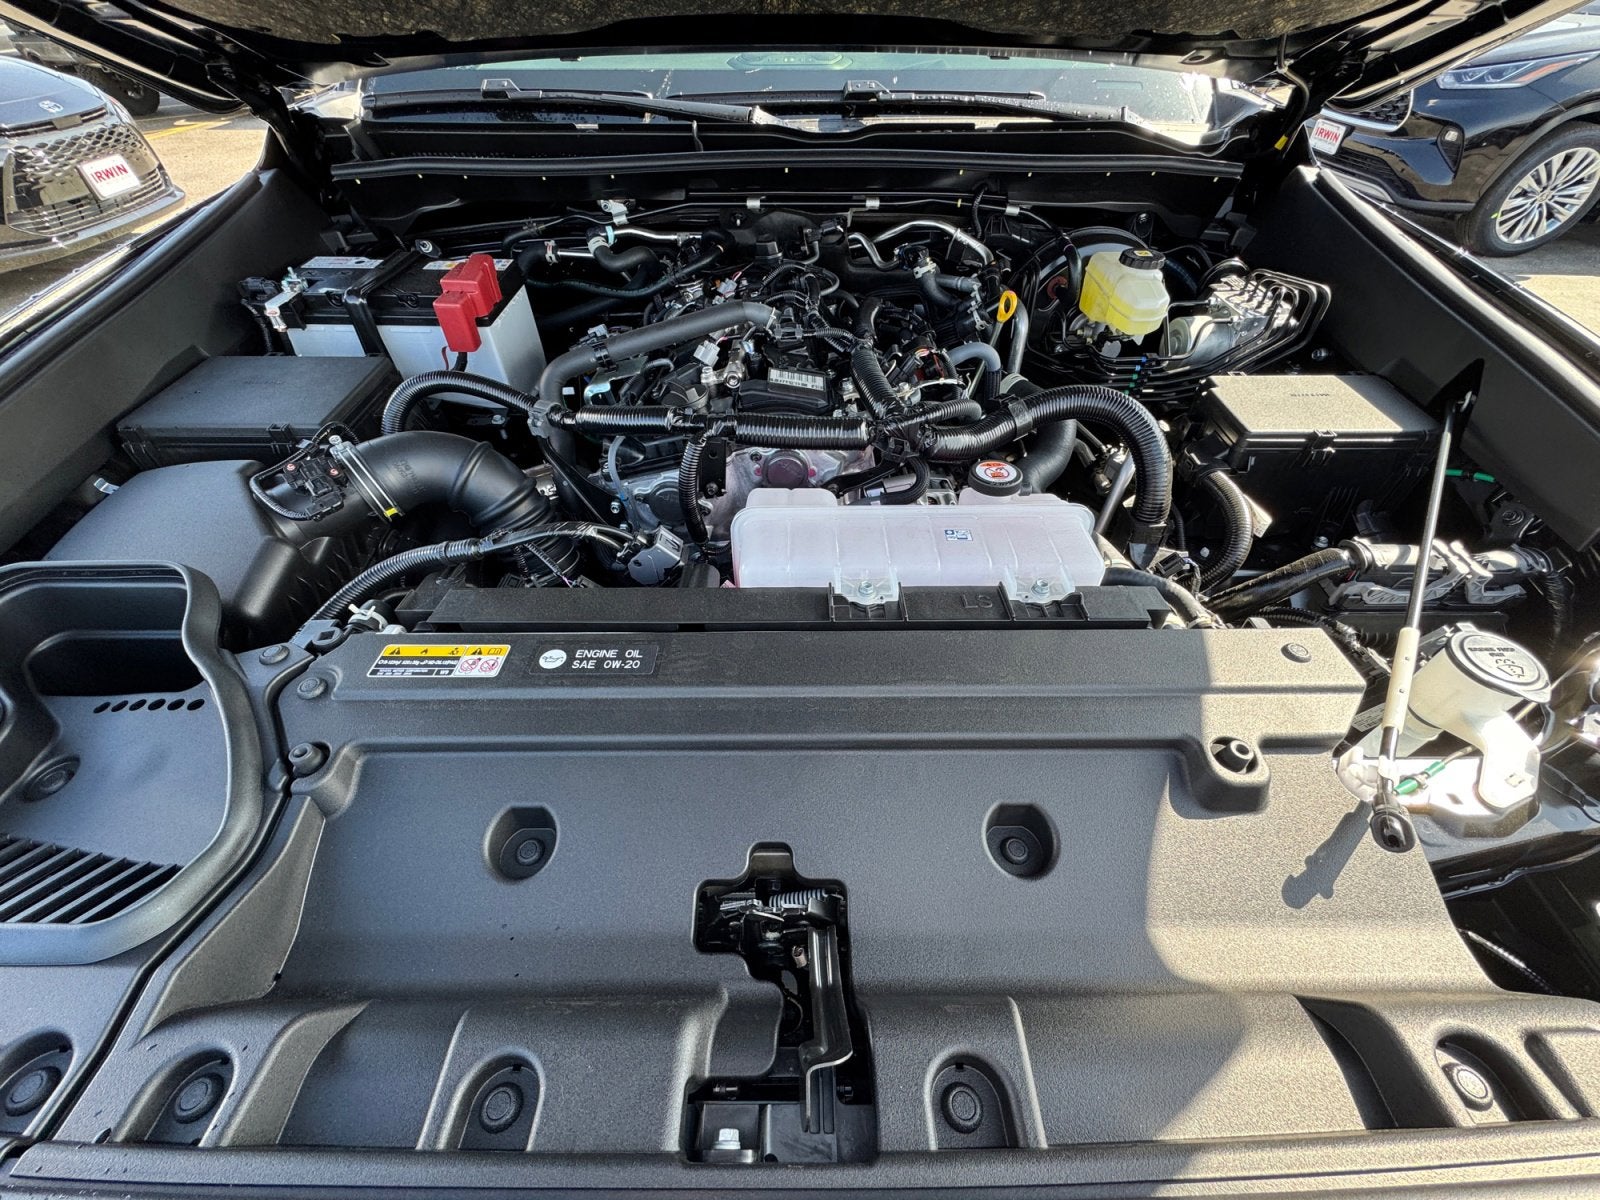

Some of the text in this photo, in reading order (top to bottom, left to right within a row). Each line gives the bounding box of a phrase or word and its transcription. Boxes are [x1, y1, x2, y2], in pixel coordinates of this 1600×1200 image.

[1315, 127, 1341, 143] IRWIN
[90, 163, 129, 184] IRWIN
[575, 649, 643, 658] ENGINE OIL
[571, 660, 641, 669] SAE 0W-20
